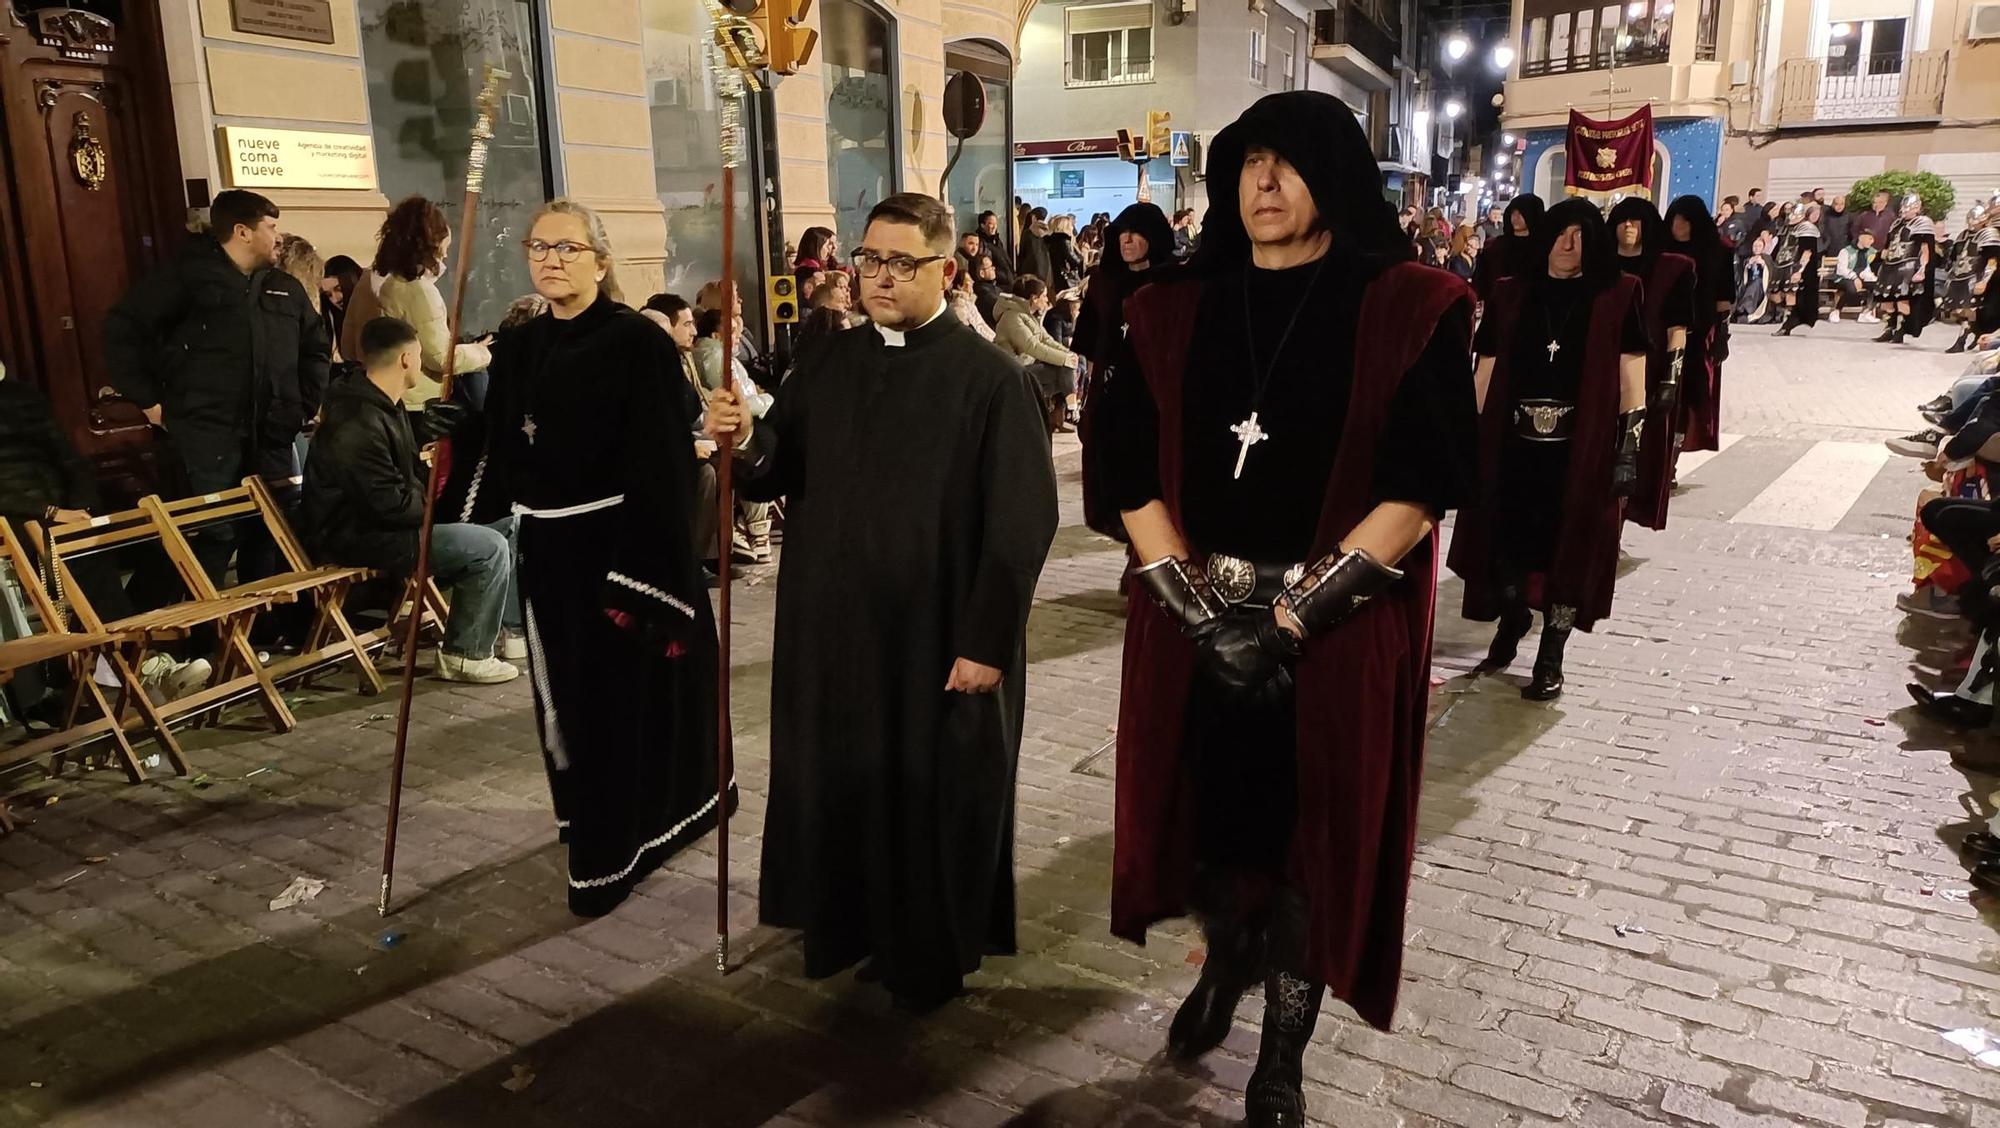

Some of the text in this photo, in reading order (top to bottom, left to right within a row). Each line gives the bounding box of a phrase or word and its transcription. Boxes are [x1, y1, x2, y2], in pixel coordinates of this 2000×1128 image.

[238, 138, 280, 150] nueve
[1067, 141, 1098, 152] Bar
[240, 151, 278, 163] coma
[241, 165, 284, 176] nueve
